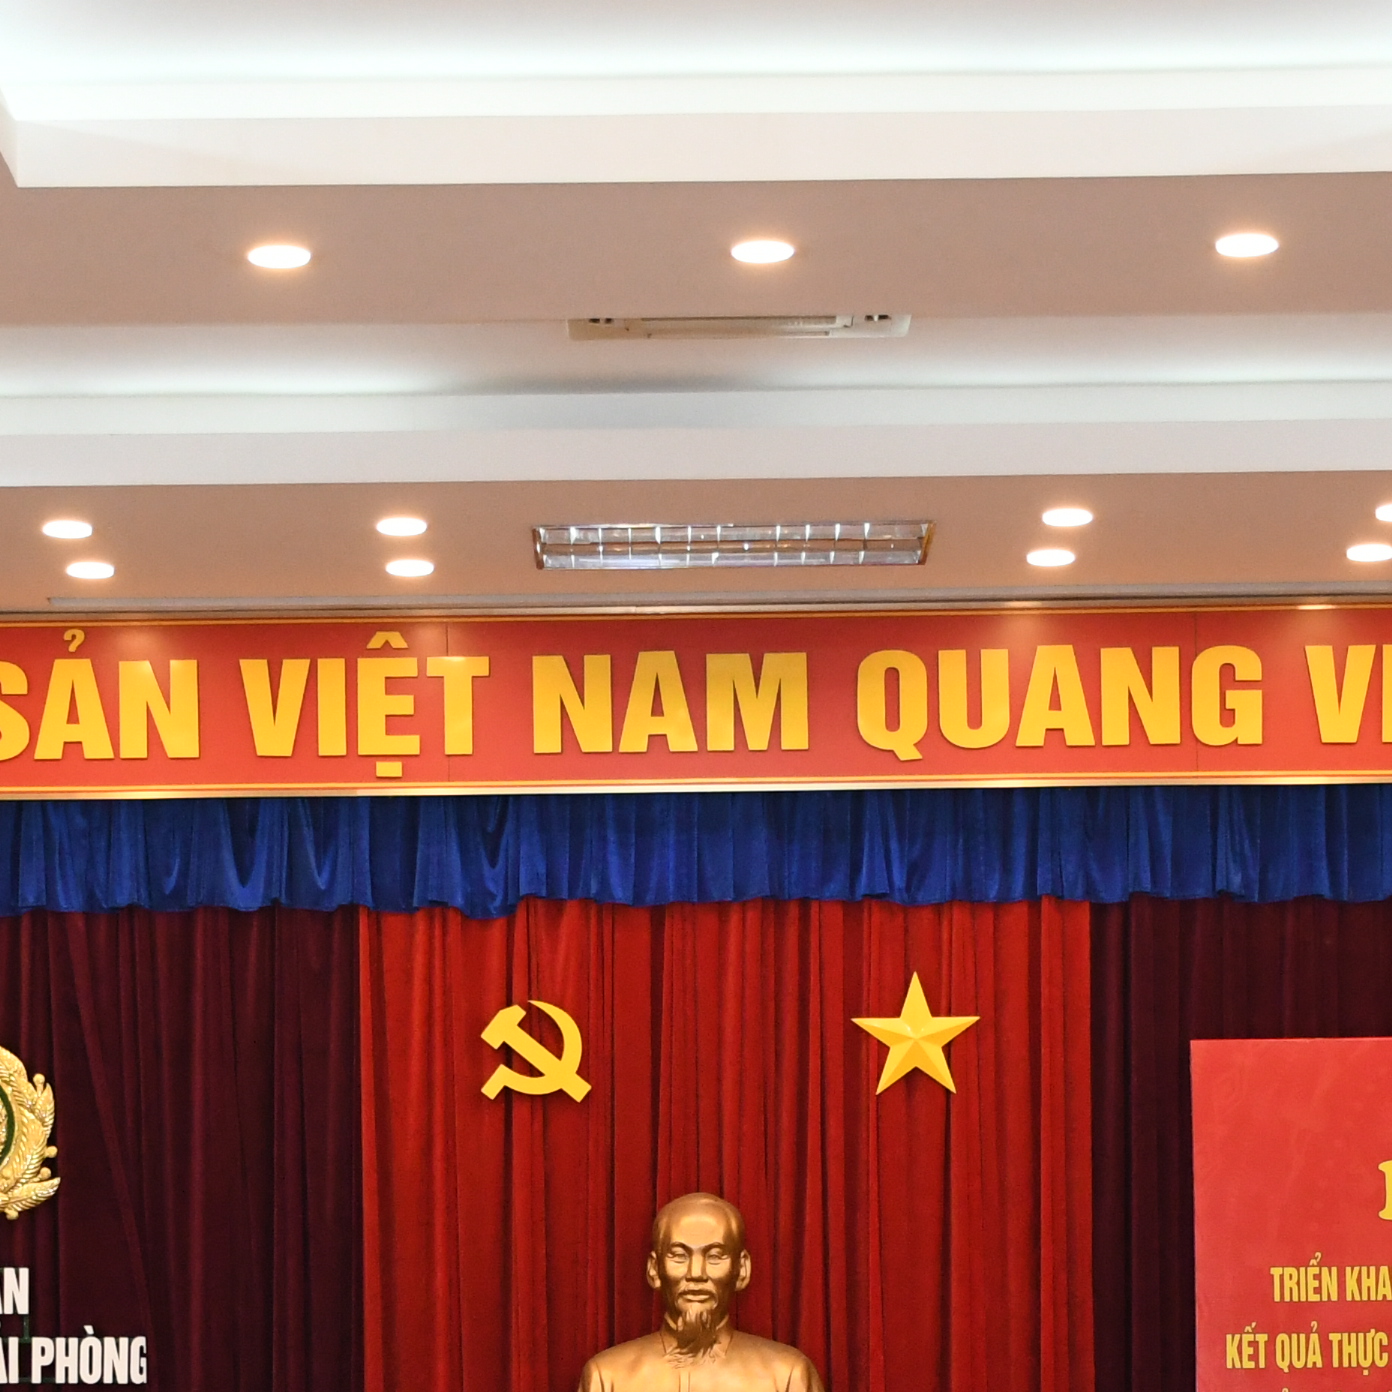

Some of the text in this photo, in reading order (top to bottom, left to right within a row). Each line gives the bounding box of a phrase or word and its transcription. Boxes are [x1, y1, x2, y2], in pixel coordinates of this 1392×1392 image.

[239, 630, 490, 777] VIỆT
[533, 651, 808, 753] NAM
[856, 644, 1264, 760] QUANG
[1271, 1255, 1337, 1301] TRIỂN
[32, 1325, 146, 1384] PHÒNG
[1226, 1322, 1268, 1368] KẾT
[1276, 1321, 1322, 1372] QUẢ
[1329, 1329, 1388, 1375] THỰC
